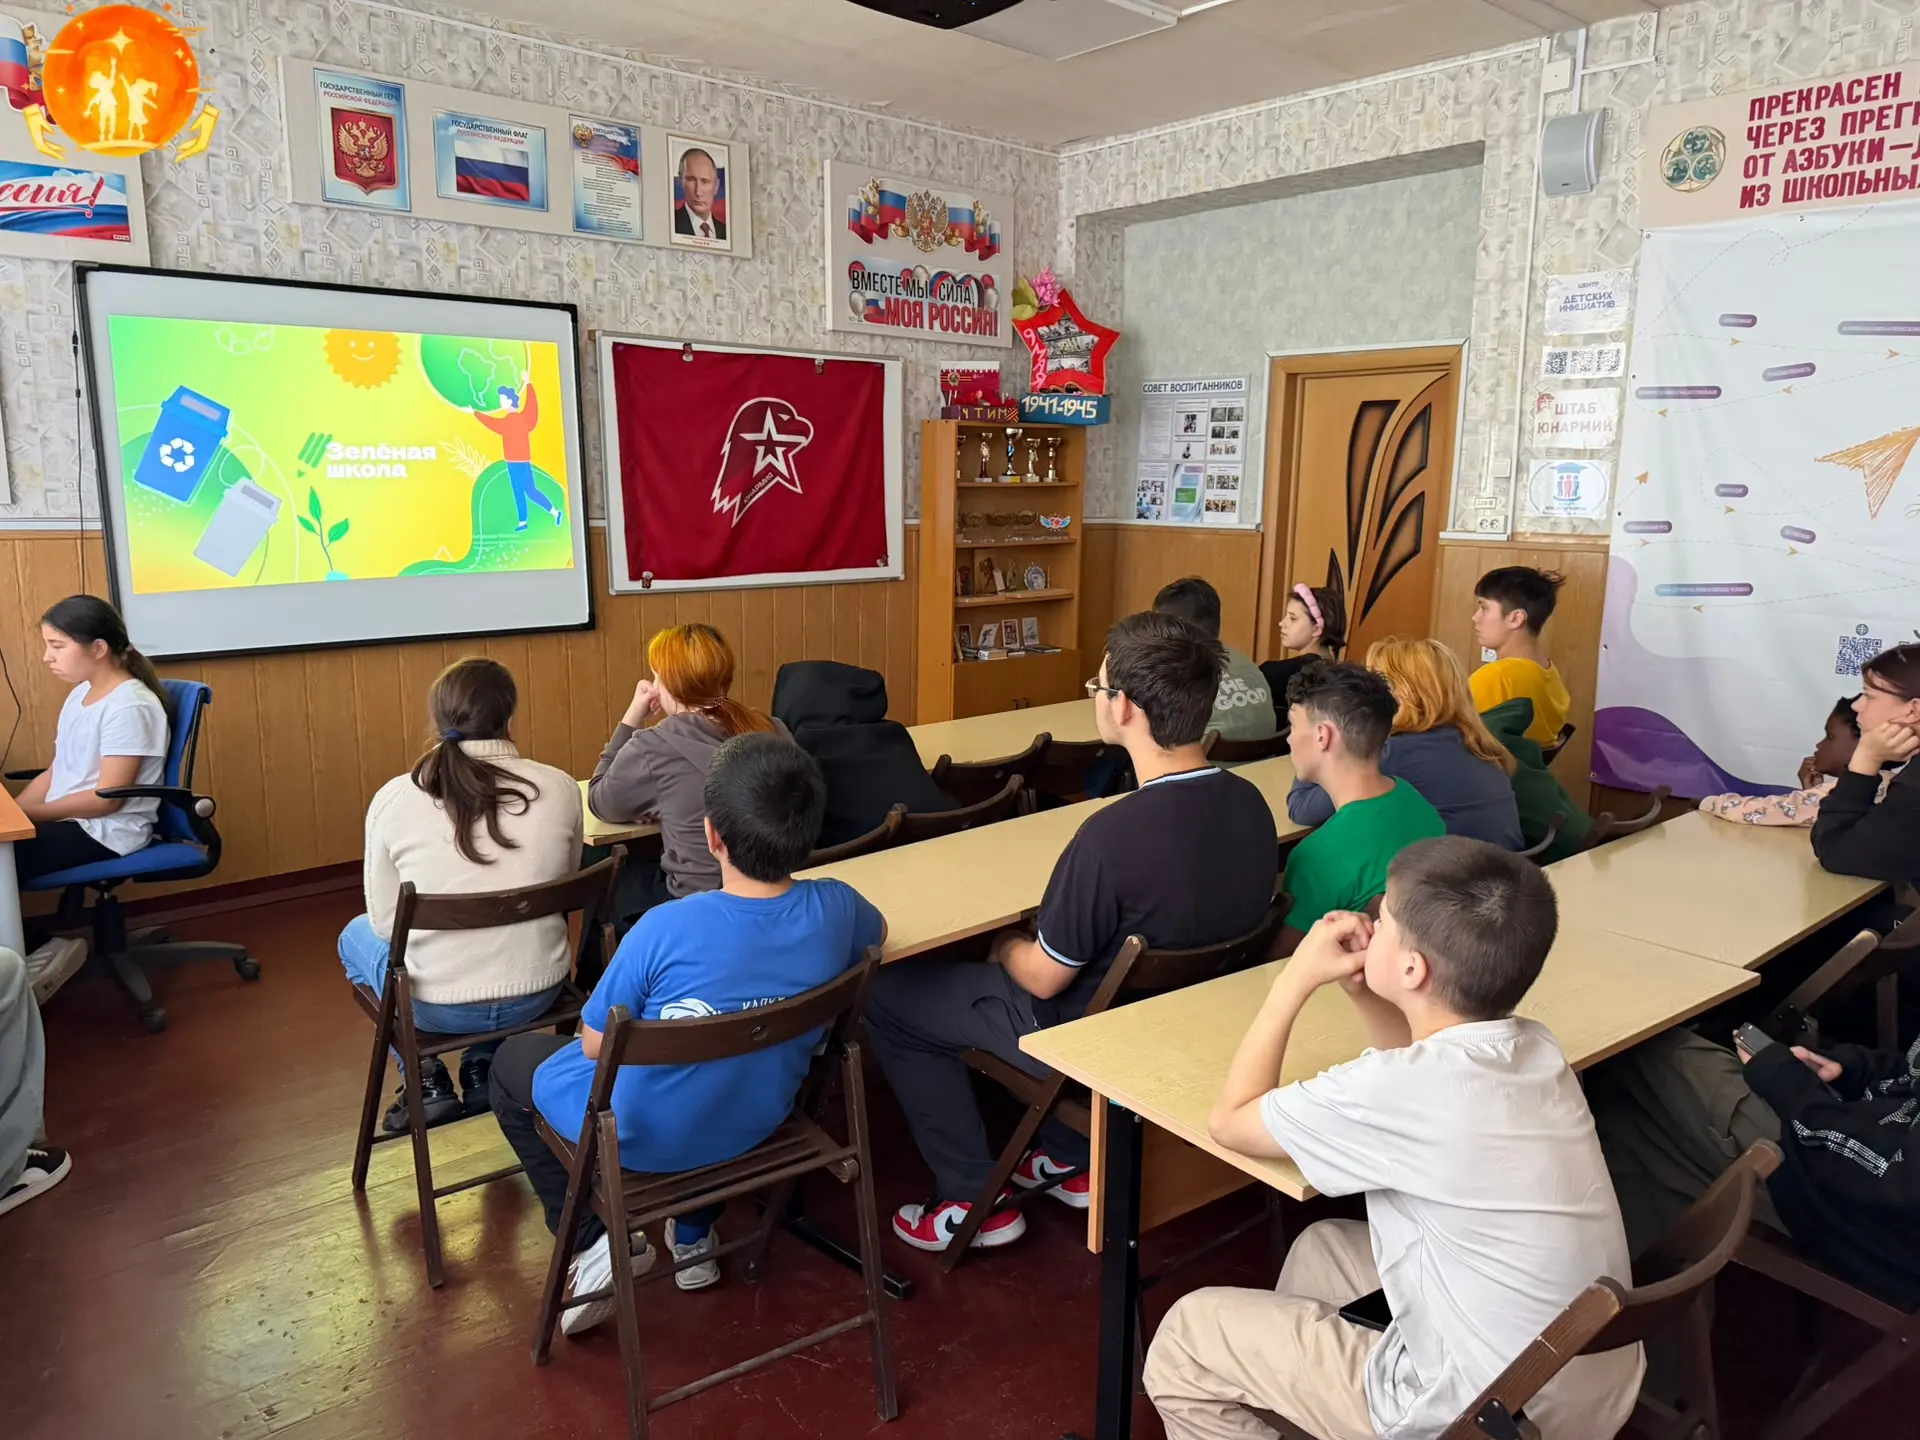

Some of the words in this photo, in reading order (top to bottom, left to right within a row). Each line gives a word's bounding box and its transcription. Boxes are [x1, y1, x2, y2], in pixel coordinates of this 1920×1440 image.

[320, 81, 383, 98] ГОСУДАРСТВЕННЫЙ
[323, 90, 362, 103] РОССИЙСКОЙ
[1749, 71, 1902, 122] ПРЕКРАСЕН
[451, 120, 512, 136] ГОСУДАРСТВЕННЫЙ
[513, 131, 529, 139] ФЛАГ
[457, 128, 493, 140] РОССИЙСКОЙ
[1746, 116, 1826, 149] ЧЕРЕЗ
[1743, 152, 1776, 179] ОТ
[1739, 183, 1771, 209] ИЗ
[1782, 164, 1920, 203] ШКОЛЬНЫ
[851, 270, 902, 296] ВМЕСТЕ
[906, 279, 929, 299] МЫ
[938, 282, 976, 306] СИЛА,
[1577, 281, 1600, 289] ЦЕНТР
[1560, 300, 1616, 312] ИНИЦИАТИВ
[1563, 291, 1613, 304] ДЕТСКИХ
[884, 296, 925, 329] МОЯ
[929, 302, 998, 337] РОССИЯ!
[1023, 328, 1036, 346] 9
[1031, 346, 1047, 390] МАЯ
[1142, 383, 1168, 393] СОВЕТ
[1170, 380, 1243, 393] ВОСПИТАННИКОВ
[1021, 395, 1098, 419] 1941-1945
[1555, 402, 1597, 415] ШТАБ
[1537, 420, 1613, 434] ЮНАРМИИ
[326, 441, 437, 461] Зелёная
[326, 463, 408, 478] школа
[744, 471, 775, 503] ЮНАРМИЯ
[1218, 678, 1248, 695] HE
[1214, 688, 1267, 710] GOOD
